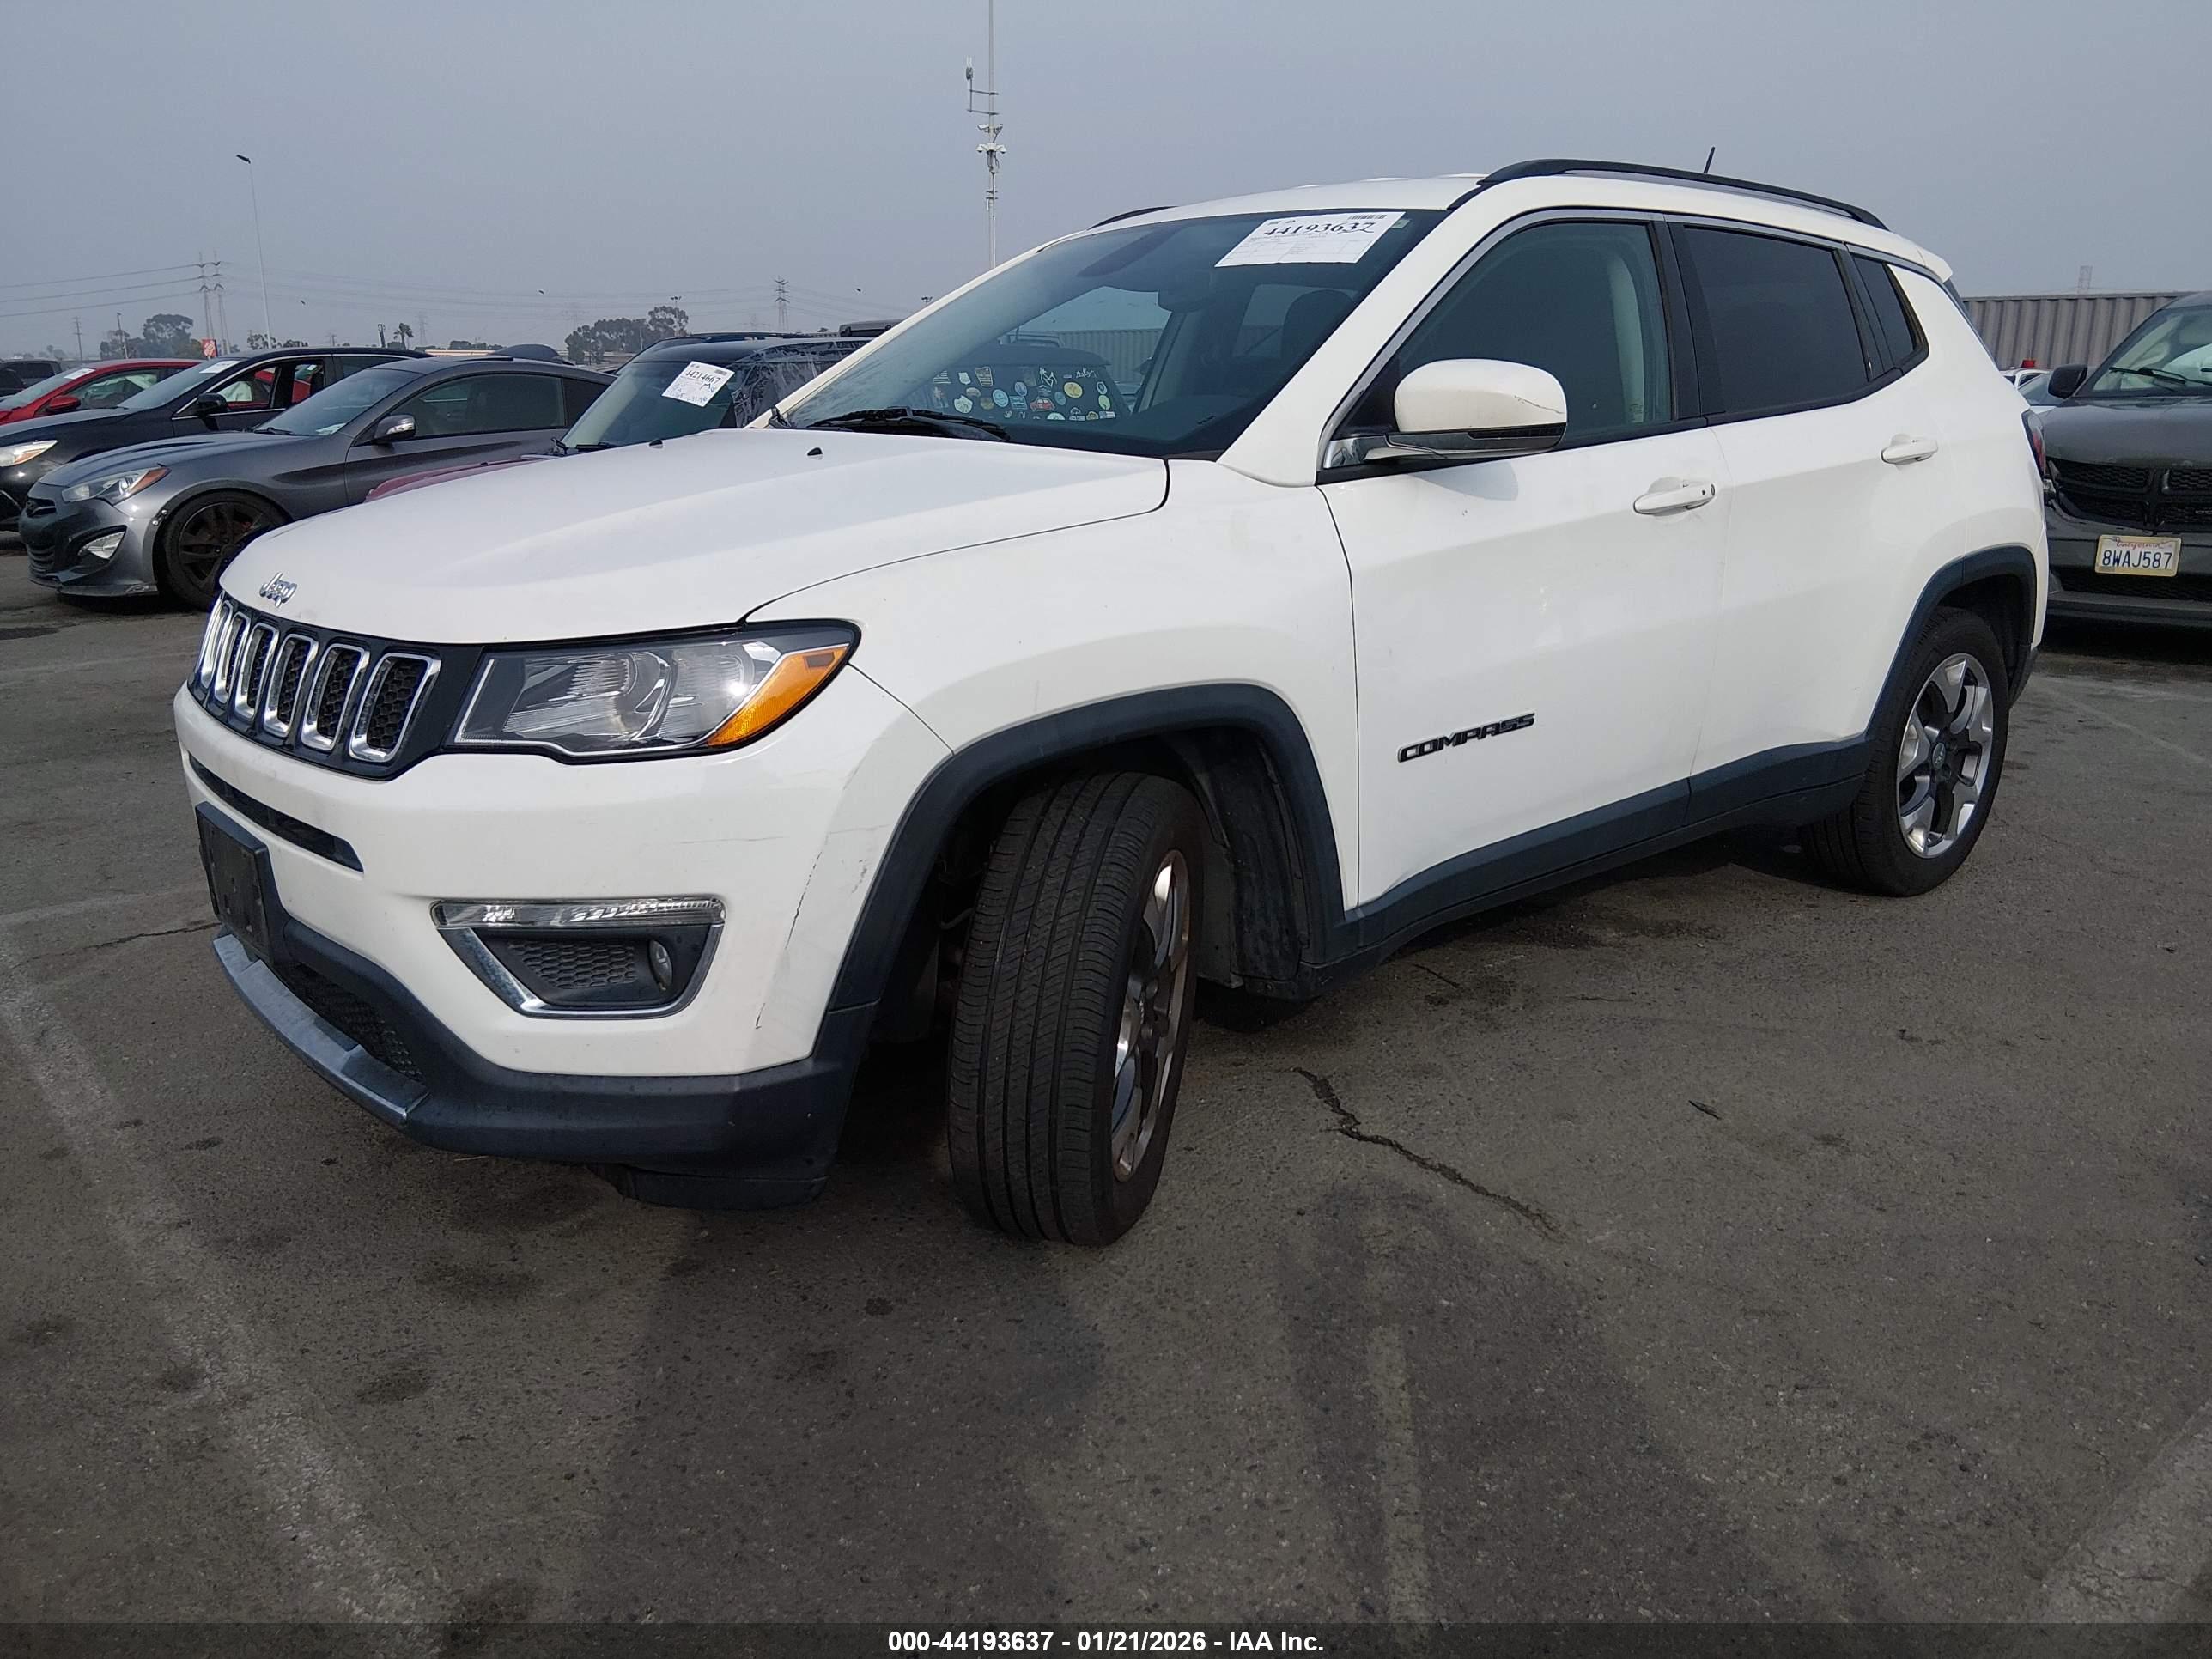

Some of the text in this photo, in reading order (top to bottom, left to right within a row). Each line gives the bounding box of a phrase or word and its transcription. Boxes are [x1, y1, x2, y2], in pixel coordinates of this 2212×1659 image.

[1263, 221, 1376, 236] 44193637
[685, 370, 721, 384] 44214667
[2101, 550, 2172, 569] 8WAJ587
[259, 572, 298, 608] Jeep
[1398, 713, 1535, 763] COMPASS
